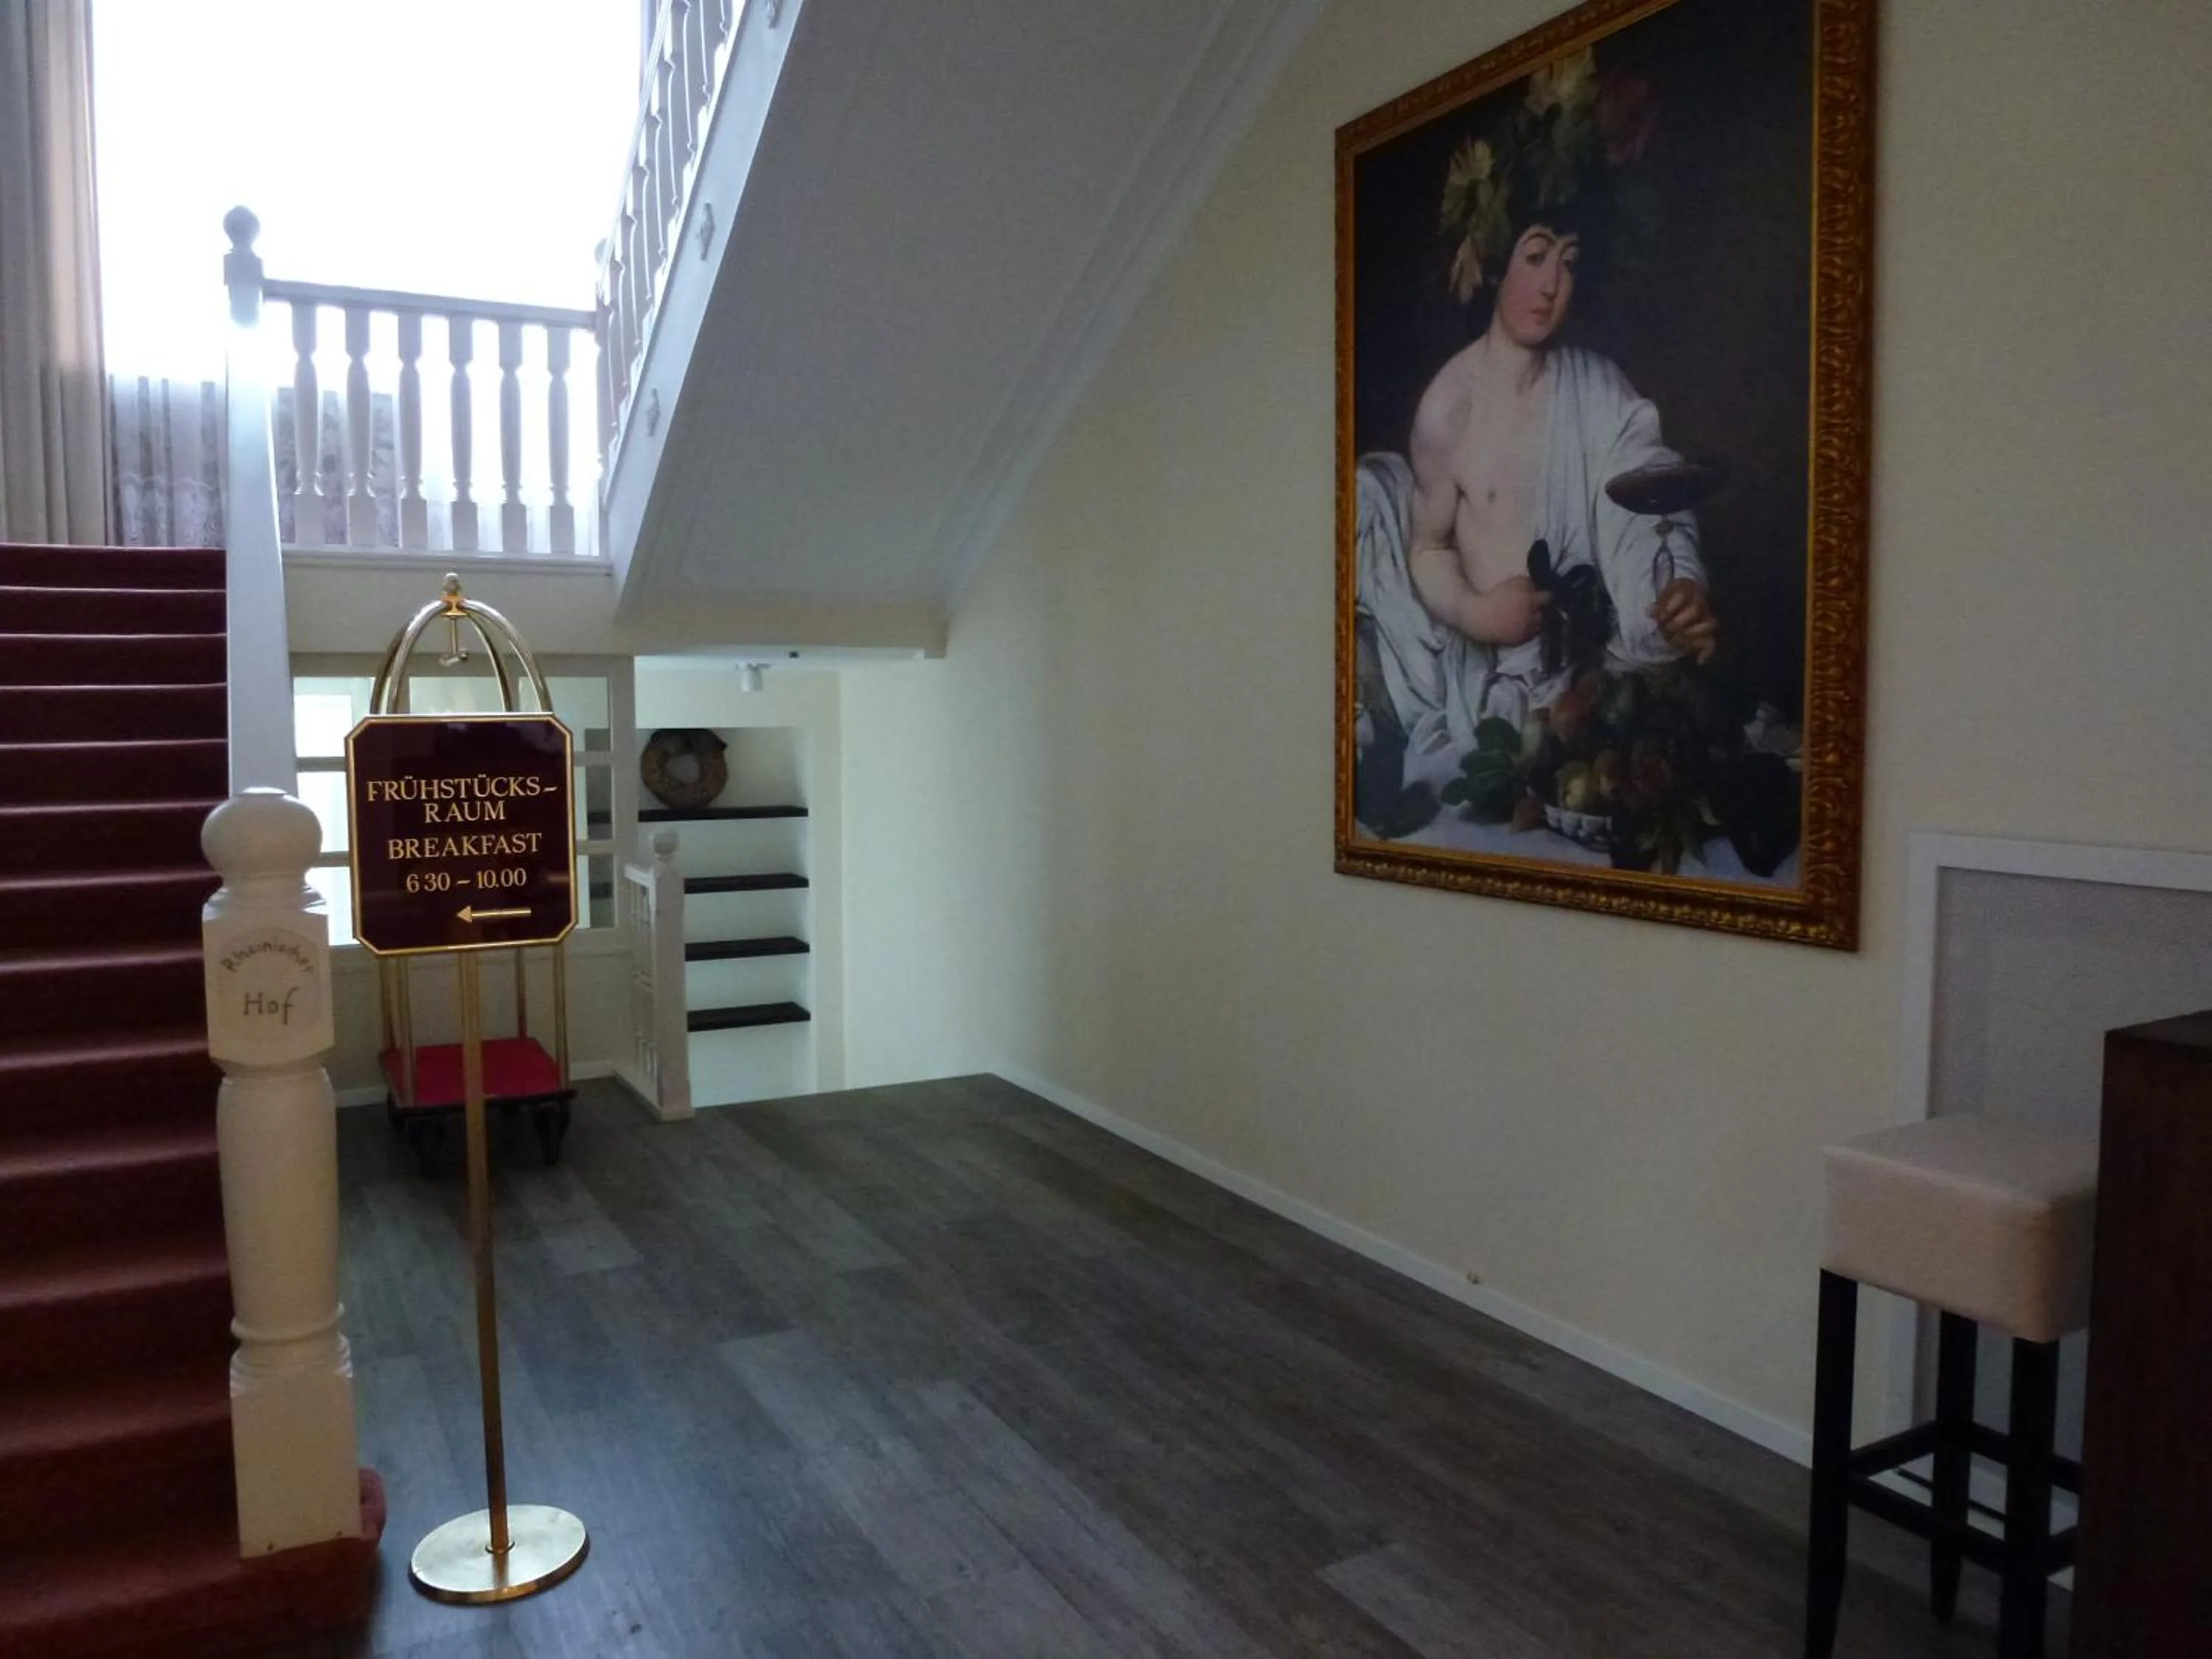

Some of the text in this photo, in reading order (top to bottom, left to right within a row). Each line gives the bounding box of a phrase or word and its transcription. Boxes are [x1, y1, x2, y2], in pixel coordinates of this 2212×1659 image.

[366, 774, 557, 802] FRÜHSTÜCKS-
[425, 801, 507, 824] RAUM
[388, 832, 542, 860] BREAKFAST
[476, 868, 527, 889] 10.00
[243, 986, 301, 1026] Hof
